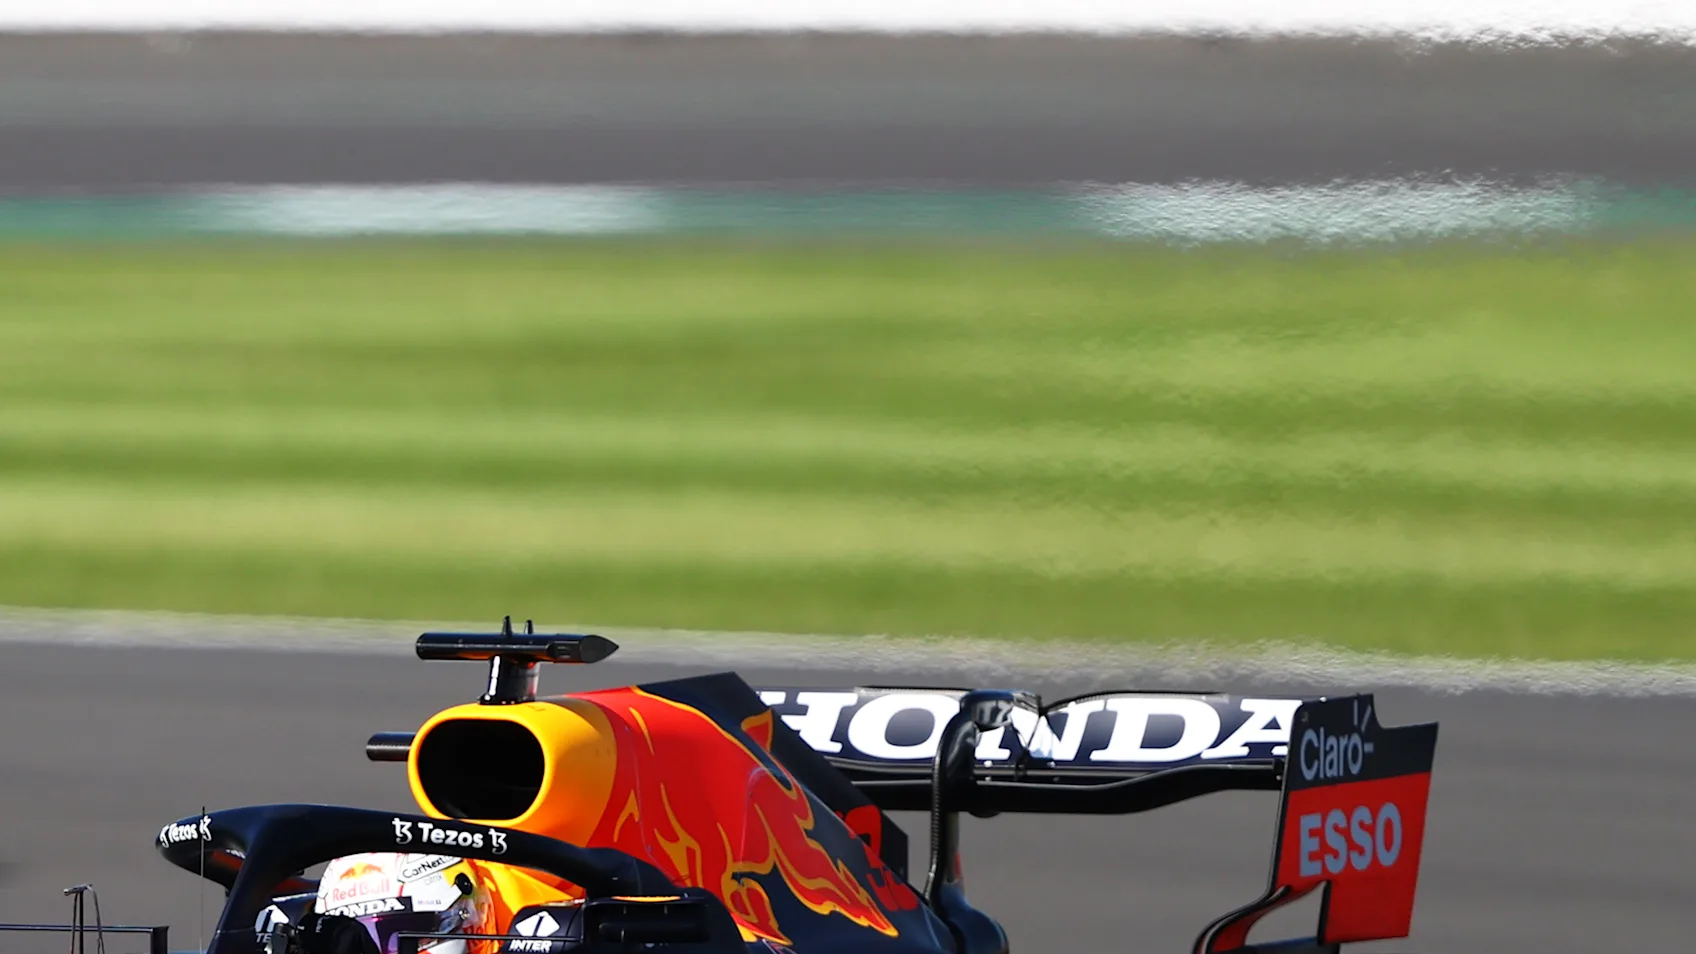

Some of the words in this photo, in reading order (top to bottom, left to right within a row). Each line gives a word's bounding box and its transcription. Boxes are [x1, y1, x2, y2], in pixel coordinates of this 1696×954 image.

[168, 823, 198, 843] Tezos
[417, 822, 484, 848] Tezos
[1300, 802, 1402, 877] ESSO
[332, 884, 357, 901] Red
[360, 878, 390, 895] Bull
[510, 940, 552, 952] INTER
